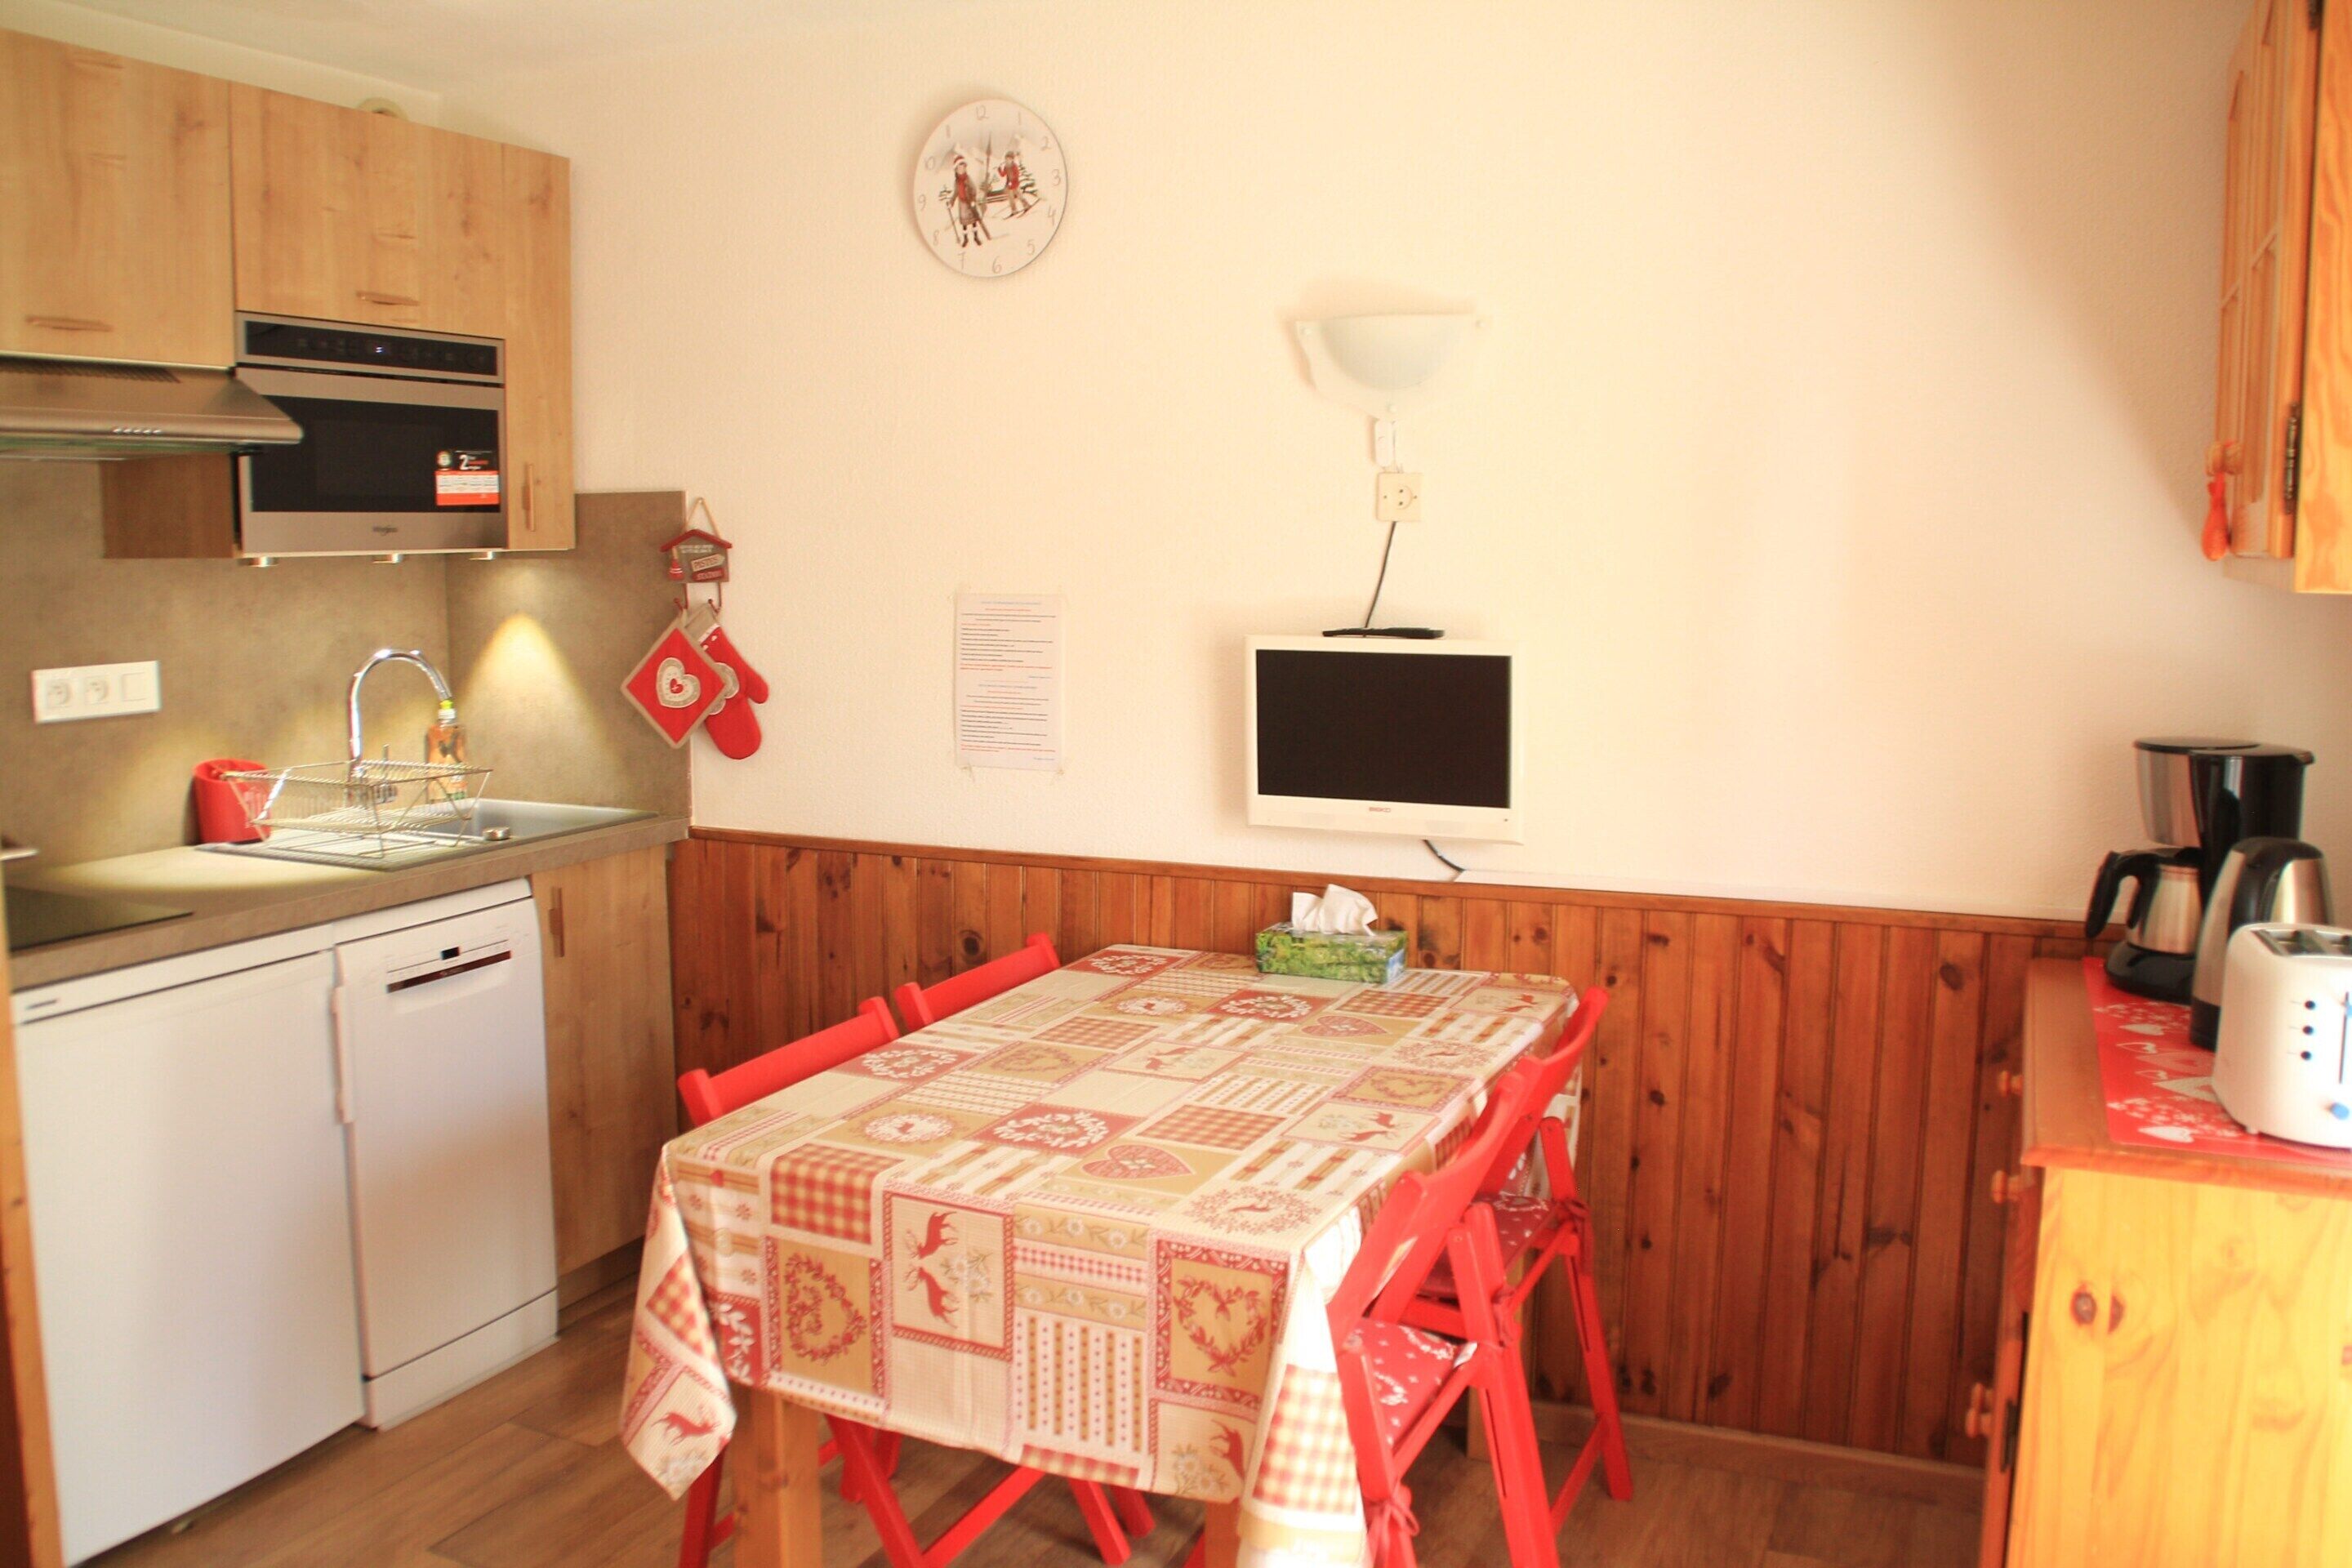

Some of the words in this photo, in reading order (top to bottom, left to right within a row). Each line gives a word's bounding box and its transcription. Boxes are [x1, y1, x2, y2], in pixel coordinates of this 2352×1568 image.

[1040, 136, 1052, 152] 2
[1050, 168, 1061, 187] 3
[918, 194, 927, 212] 9
[1046, 207, 1057, 227] 4
[1026, 238, 1036, 256] 5
[956, 252, 966, 270] 7
[991, 255, 1003, 274] 6
[459, 454, 470, 470] 2
